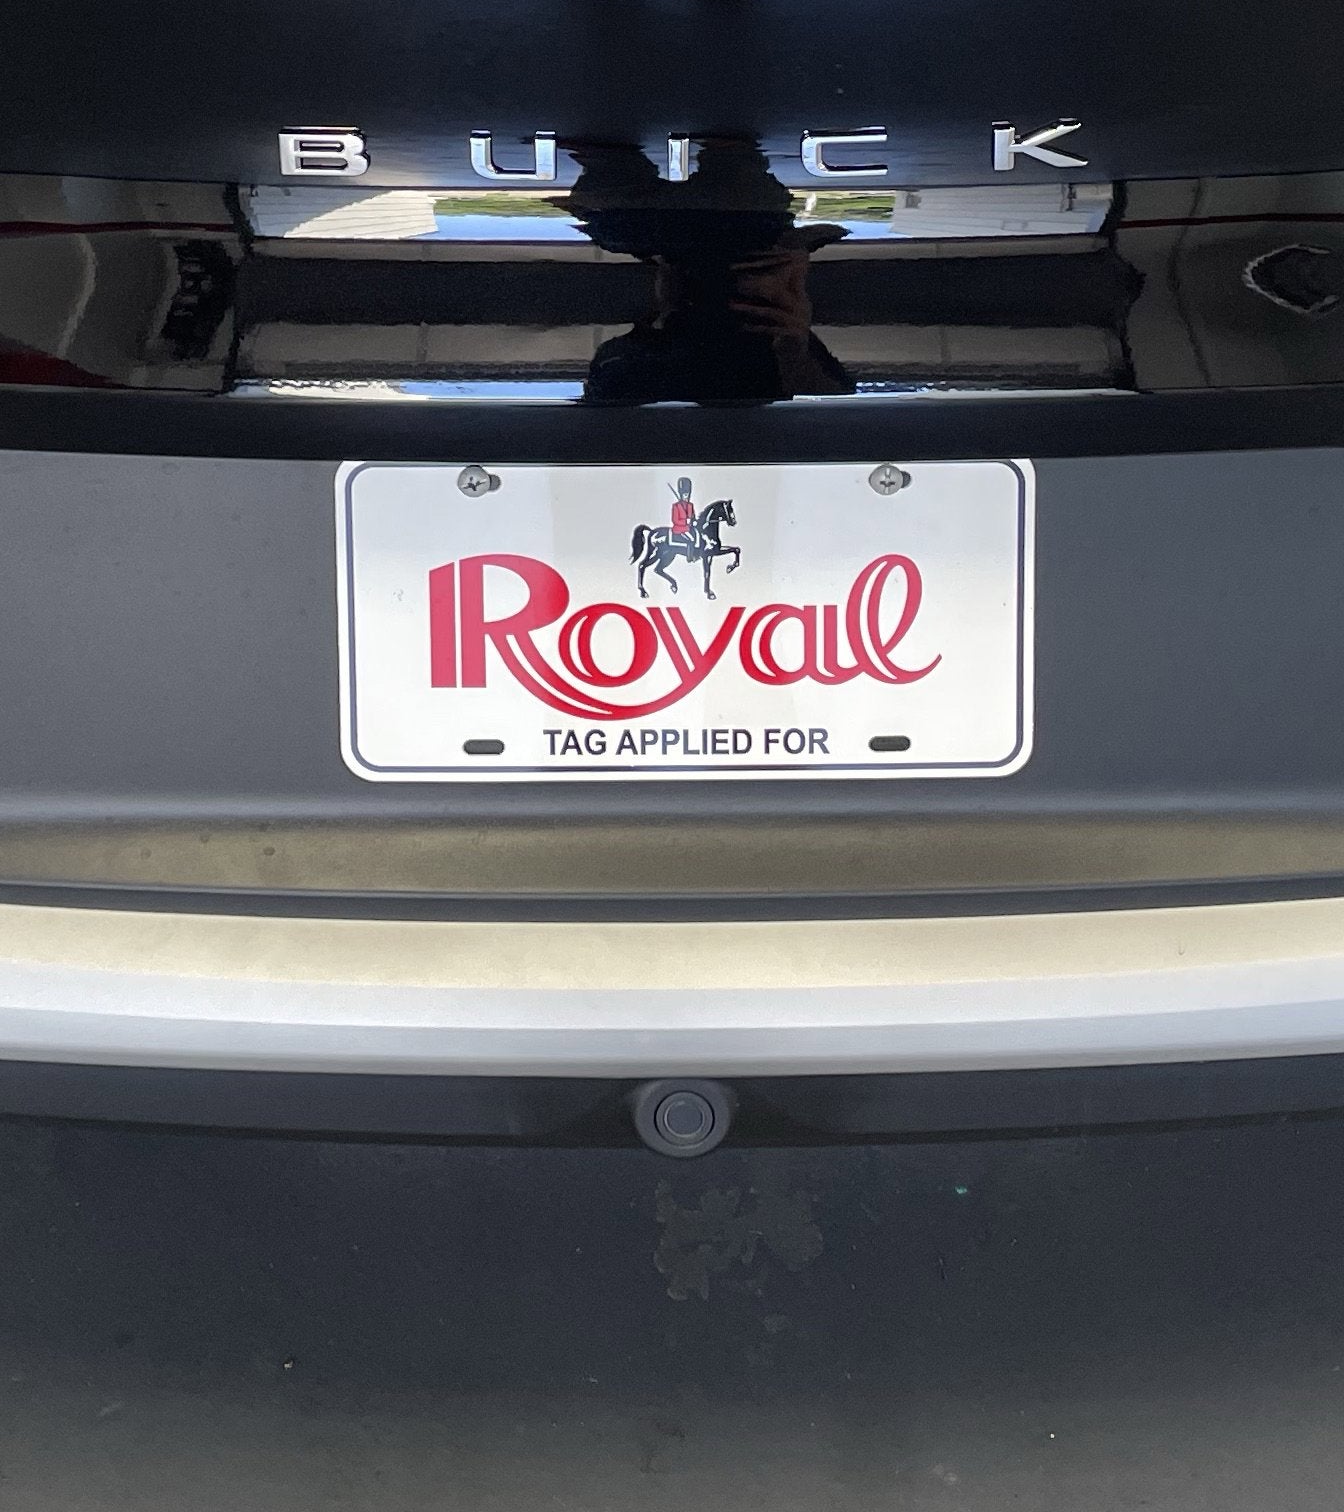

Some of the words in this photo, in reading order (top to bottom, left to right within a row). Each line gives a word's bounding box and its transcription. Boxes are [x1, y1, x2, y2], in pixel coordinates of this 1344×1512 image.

[278, 117, 1090, 181] BUICK
[428, 553, 943, 721] Royal
[542, 728, 607, 756] TAG
[615, 728, 753, 756] APPLIED
[763, 727, 831, 755] FOR
